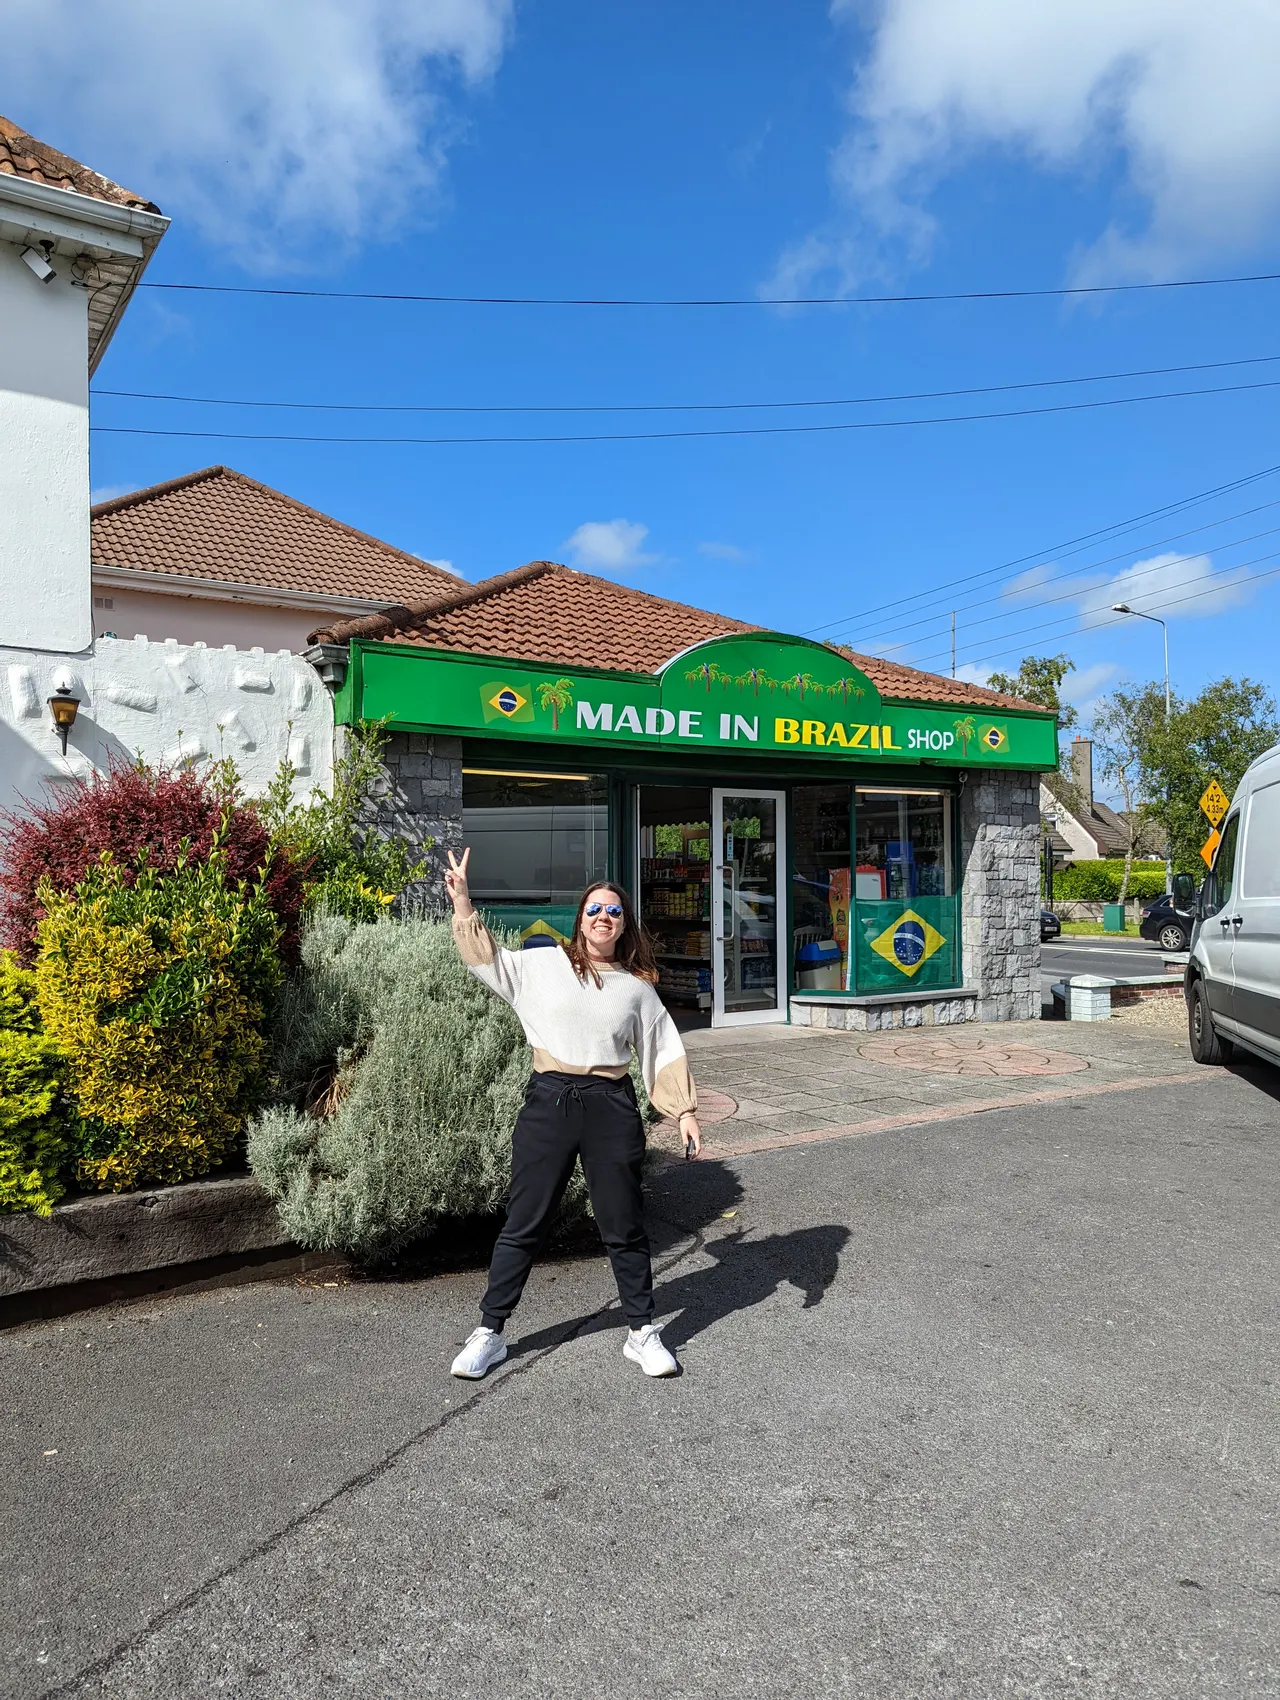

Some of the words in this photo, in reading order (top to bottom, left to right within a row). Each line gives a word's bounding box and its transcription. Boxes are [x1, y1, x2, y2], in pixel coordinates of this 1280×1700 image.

[576, 701, 704, 738] MADE
[719, 713, 759, 742] IN
[774, 717, 902, 750] BRAZIL
[907, 728, 955, 751] SHOP
